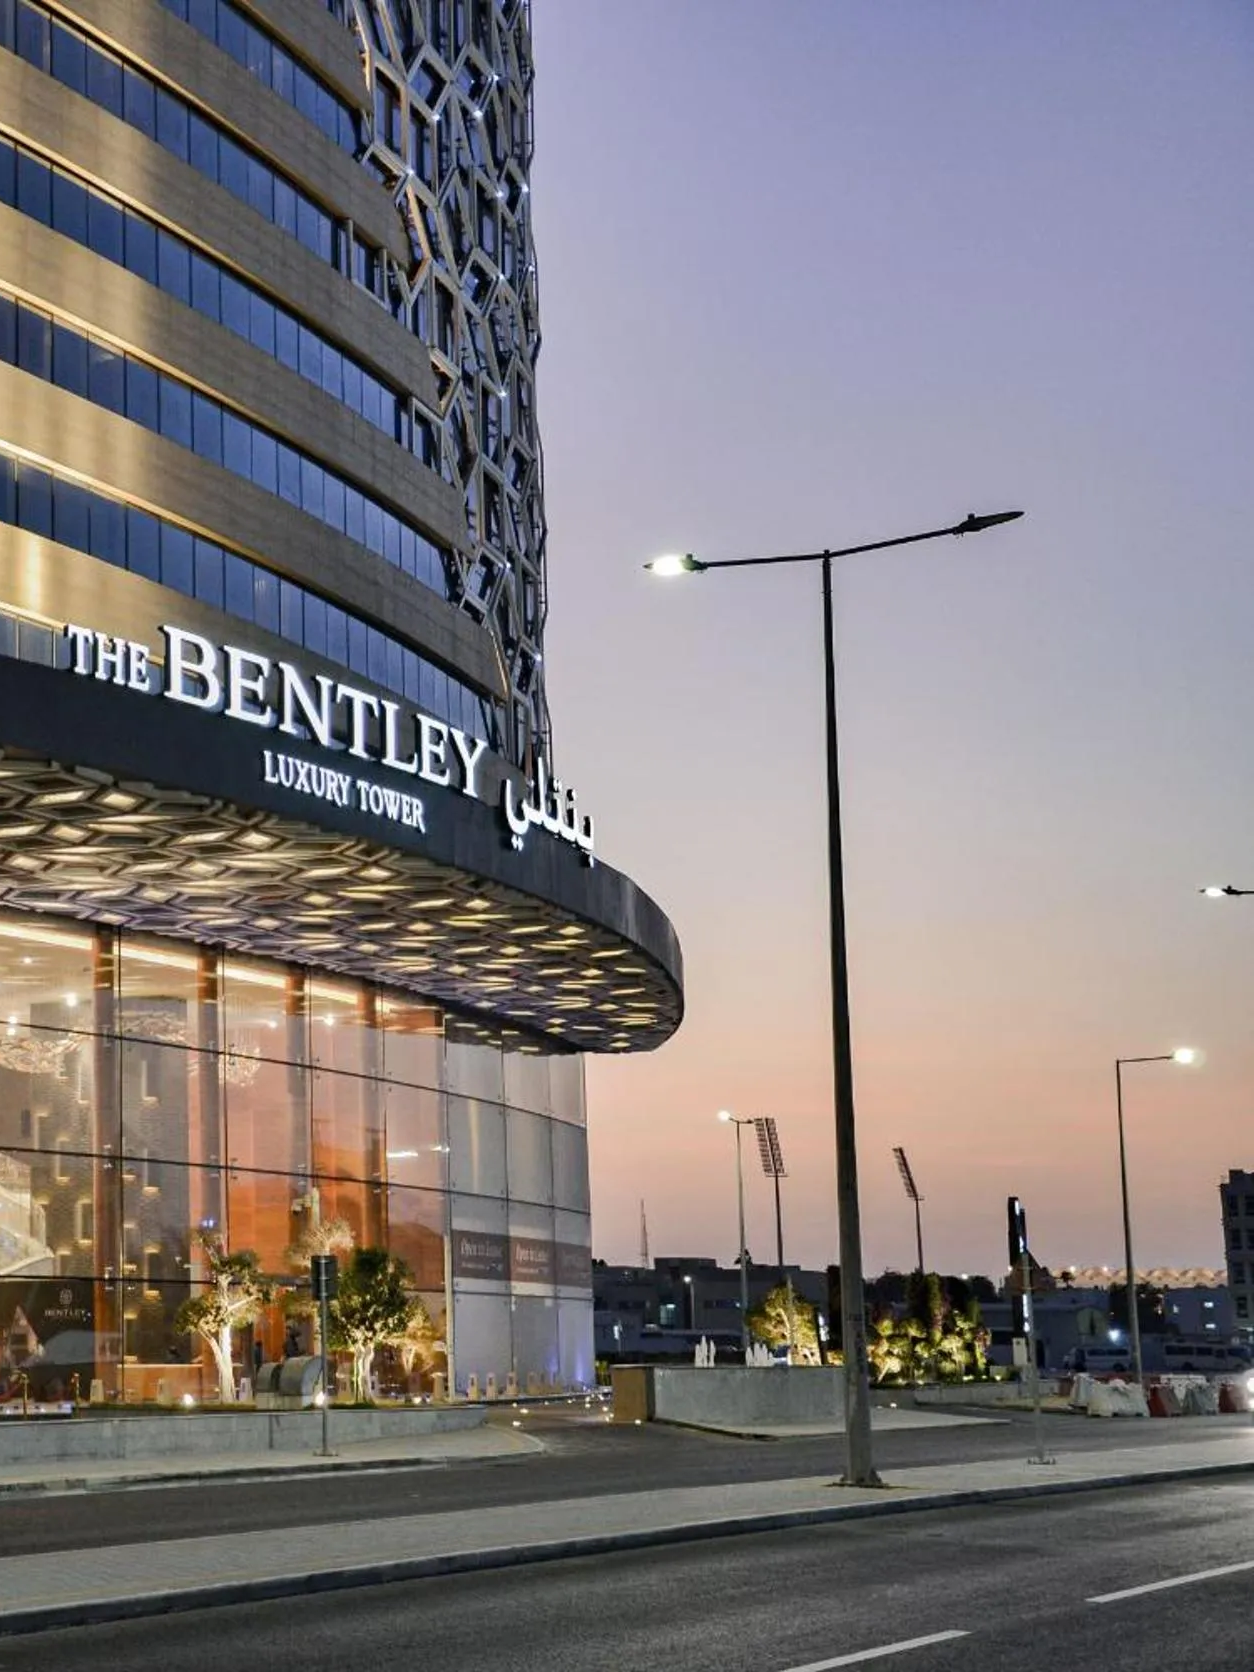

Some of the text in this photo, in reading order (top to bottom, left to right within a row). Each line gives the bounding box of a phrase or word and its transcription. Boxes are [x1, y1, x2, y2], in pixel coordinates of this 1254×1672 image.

[66, 623, 489, 798] THE BENTLEY
[263, 749, 427, 833] LUXURY TOWER
[505, 756, 595, 868] بنتلي
